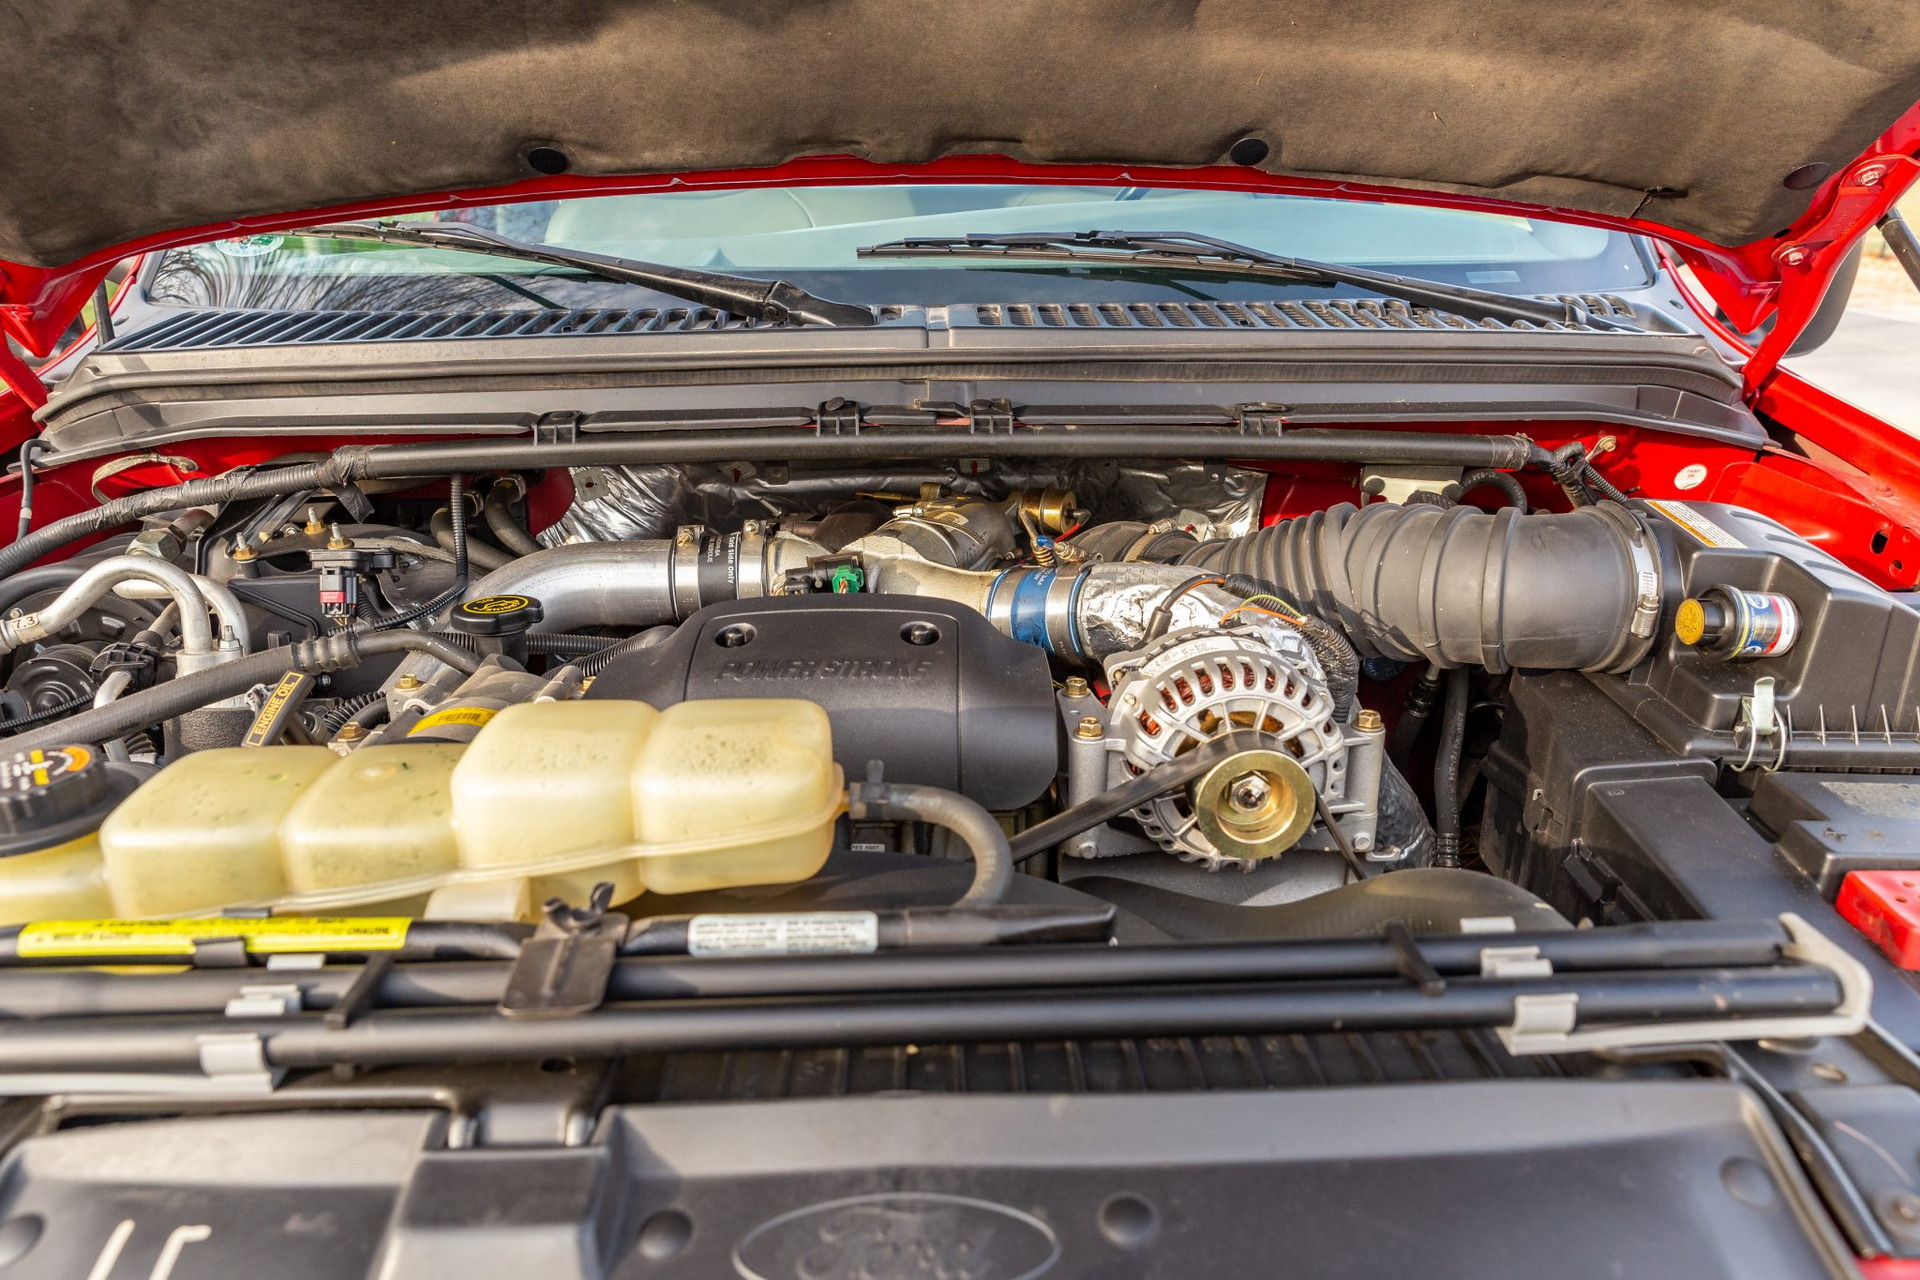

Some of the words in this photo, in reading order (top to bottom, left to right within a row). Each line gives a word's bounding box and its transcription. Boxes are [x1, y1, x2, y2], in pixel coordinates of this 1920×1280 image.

[727, 566, 735, 583] Only
[13, 616, 35, 629] 7.3
[713, 658, 816, 682] POWER
[819, 658, 932, 681] STROKE
[254, 697, 284, 735] ENGINE
[277, 681, 295, 698] OIL
